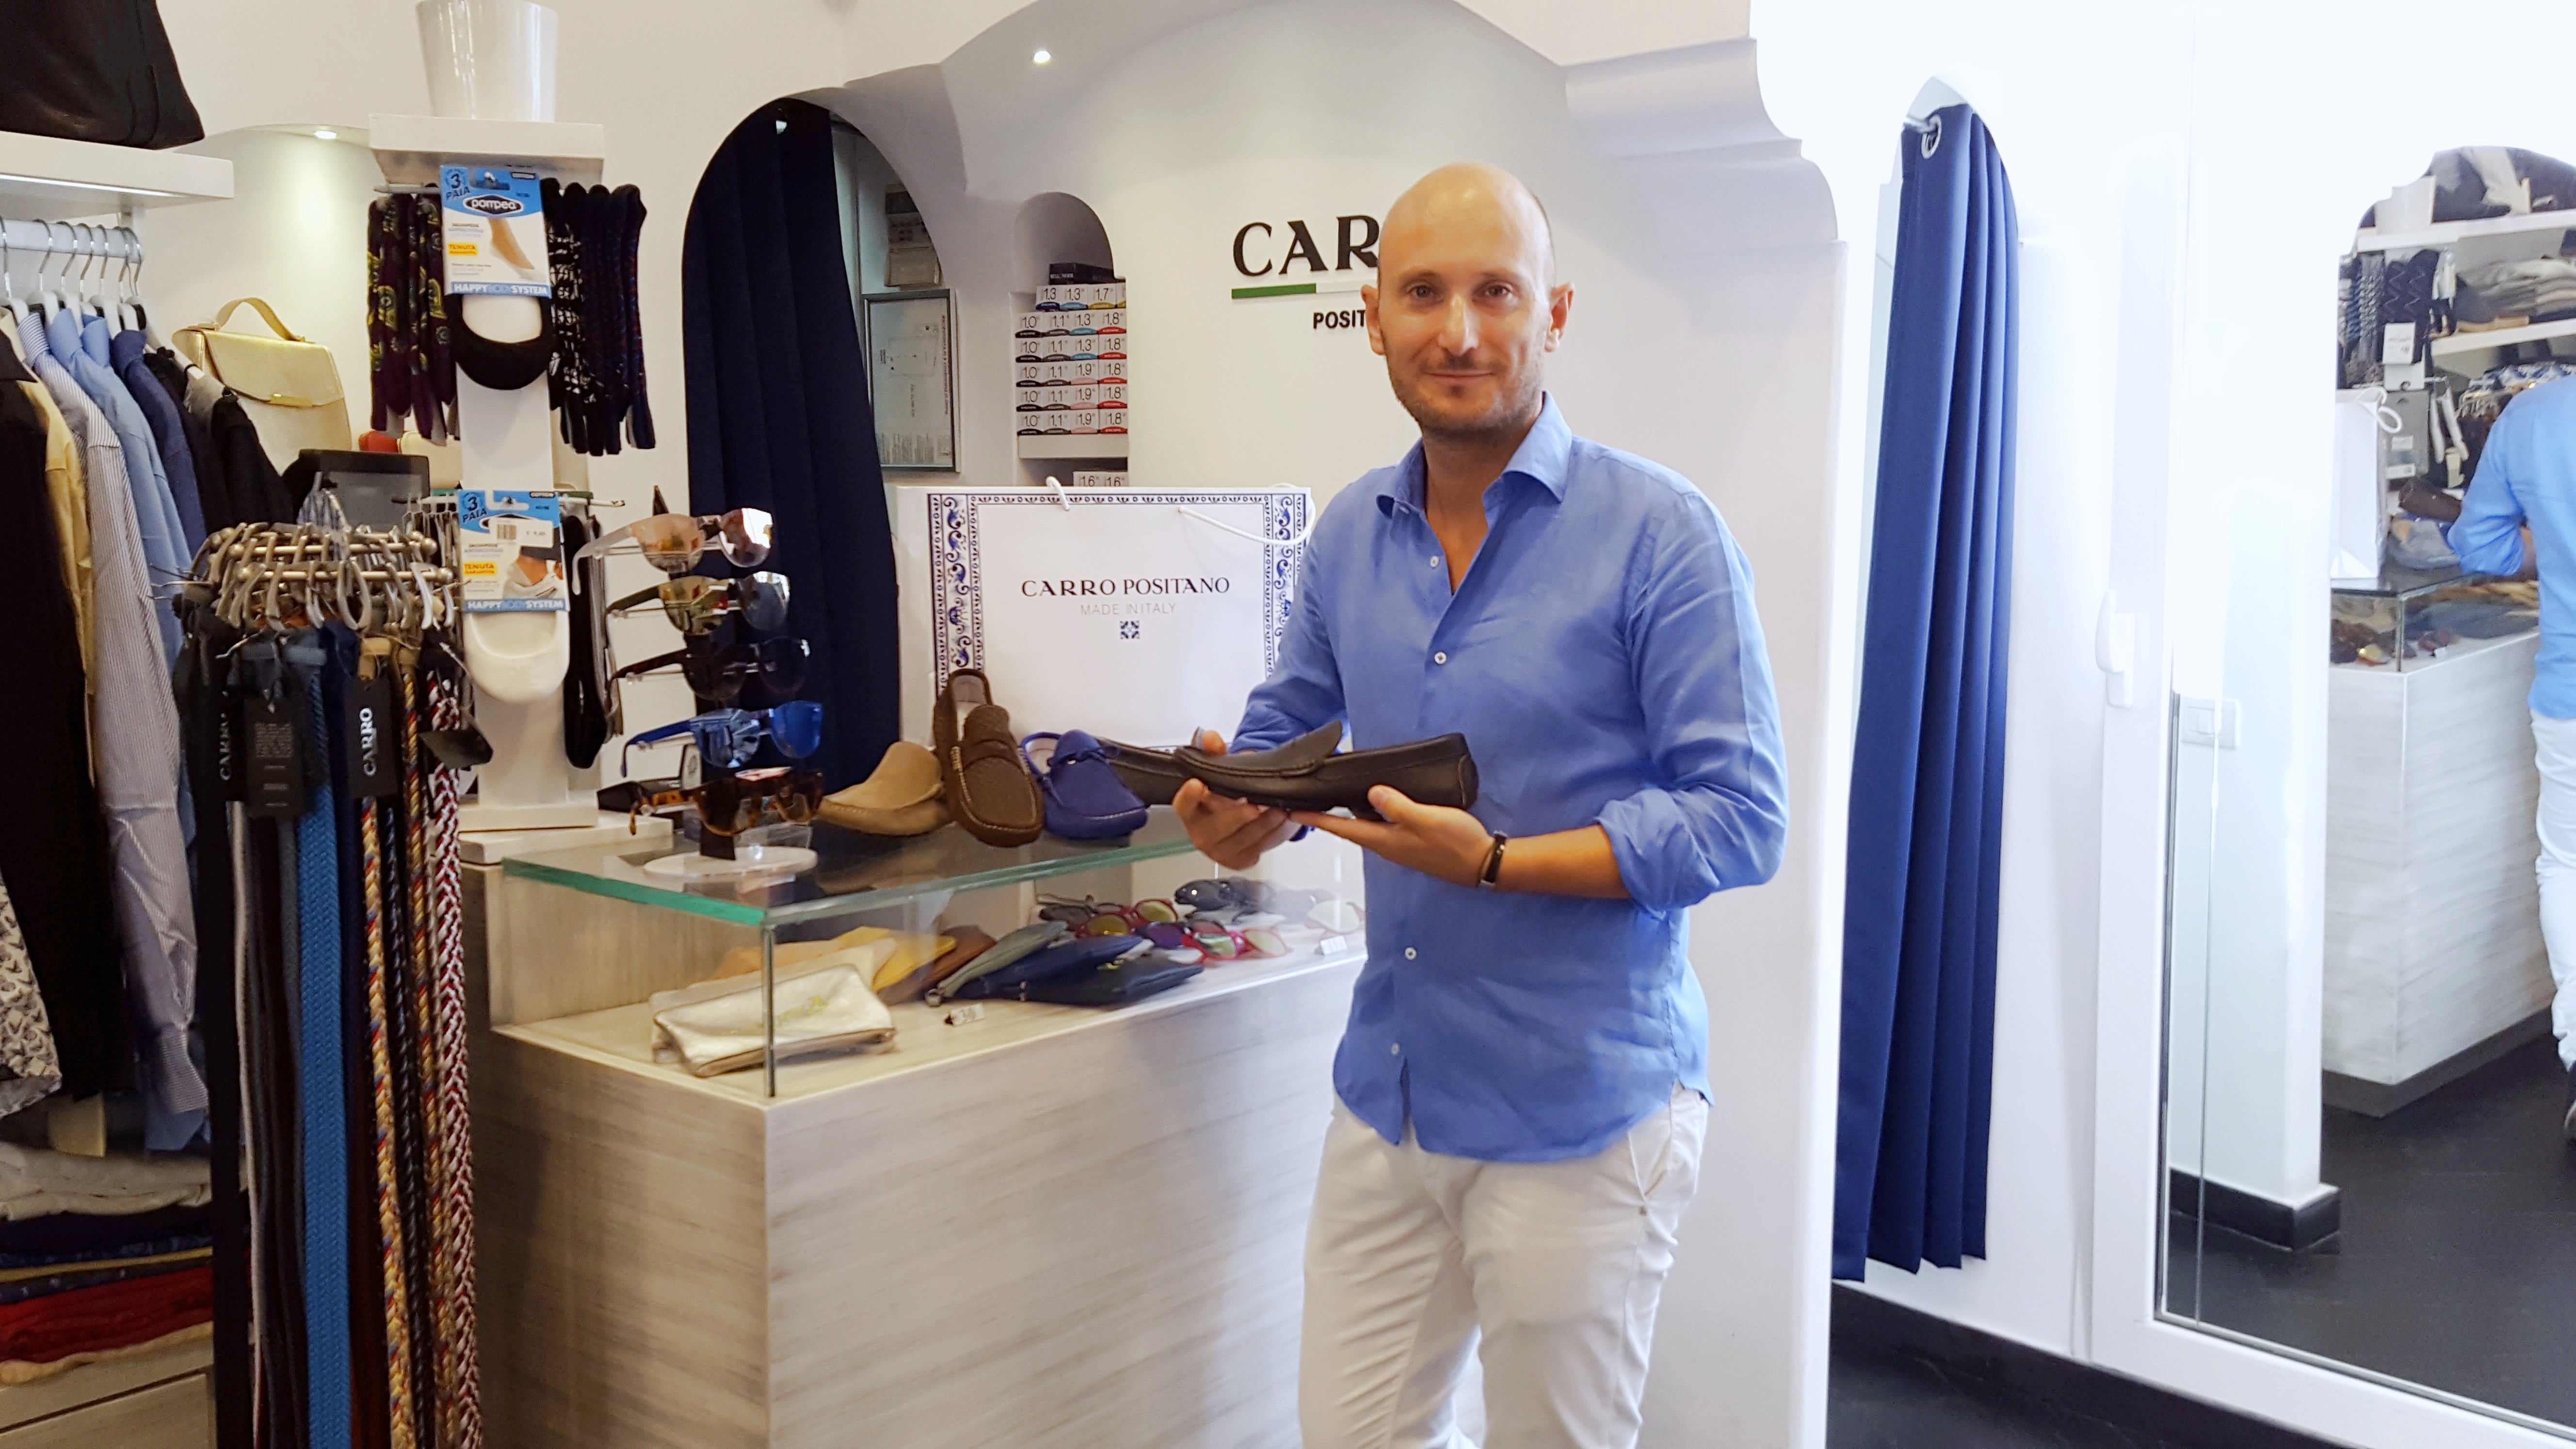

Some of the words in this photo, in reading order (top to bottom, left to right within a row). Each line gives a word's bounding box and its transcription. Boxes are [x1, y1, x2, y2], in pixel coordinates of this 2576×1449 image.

[451, 173, 460, 189] 3
[446, 186, 470, 200] PAIA
[471, 199, 516, 210] pompea
[1233, 215, 1380, 276] CAR
[1313, 310, 1366, 330] POSIT
[468, 497, 478, 511] 3
[463, 509, 487, 523] PAIA
[1022, 579, 1115, 597] CARRO
[1124, 577, 1230, 595] POSITANO
[1080, 604, 1120, 615] MADE
[1126, 603, 1137, 614] IN
[1141, 602, 1175, 614] ITALY
[359, 707, 377, 776] CARRO
